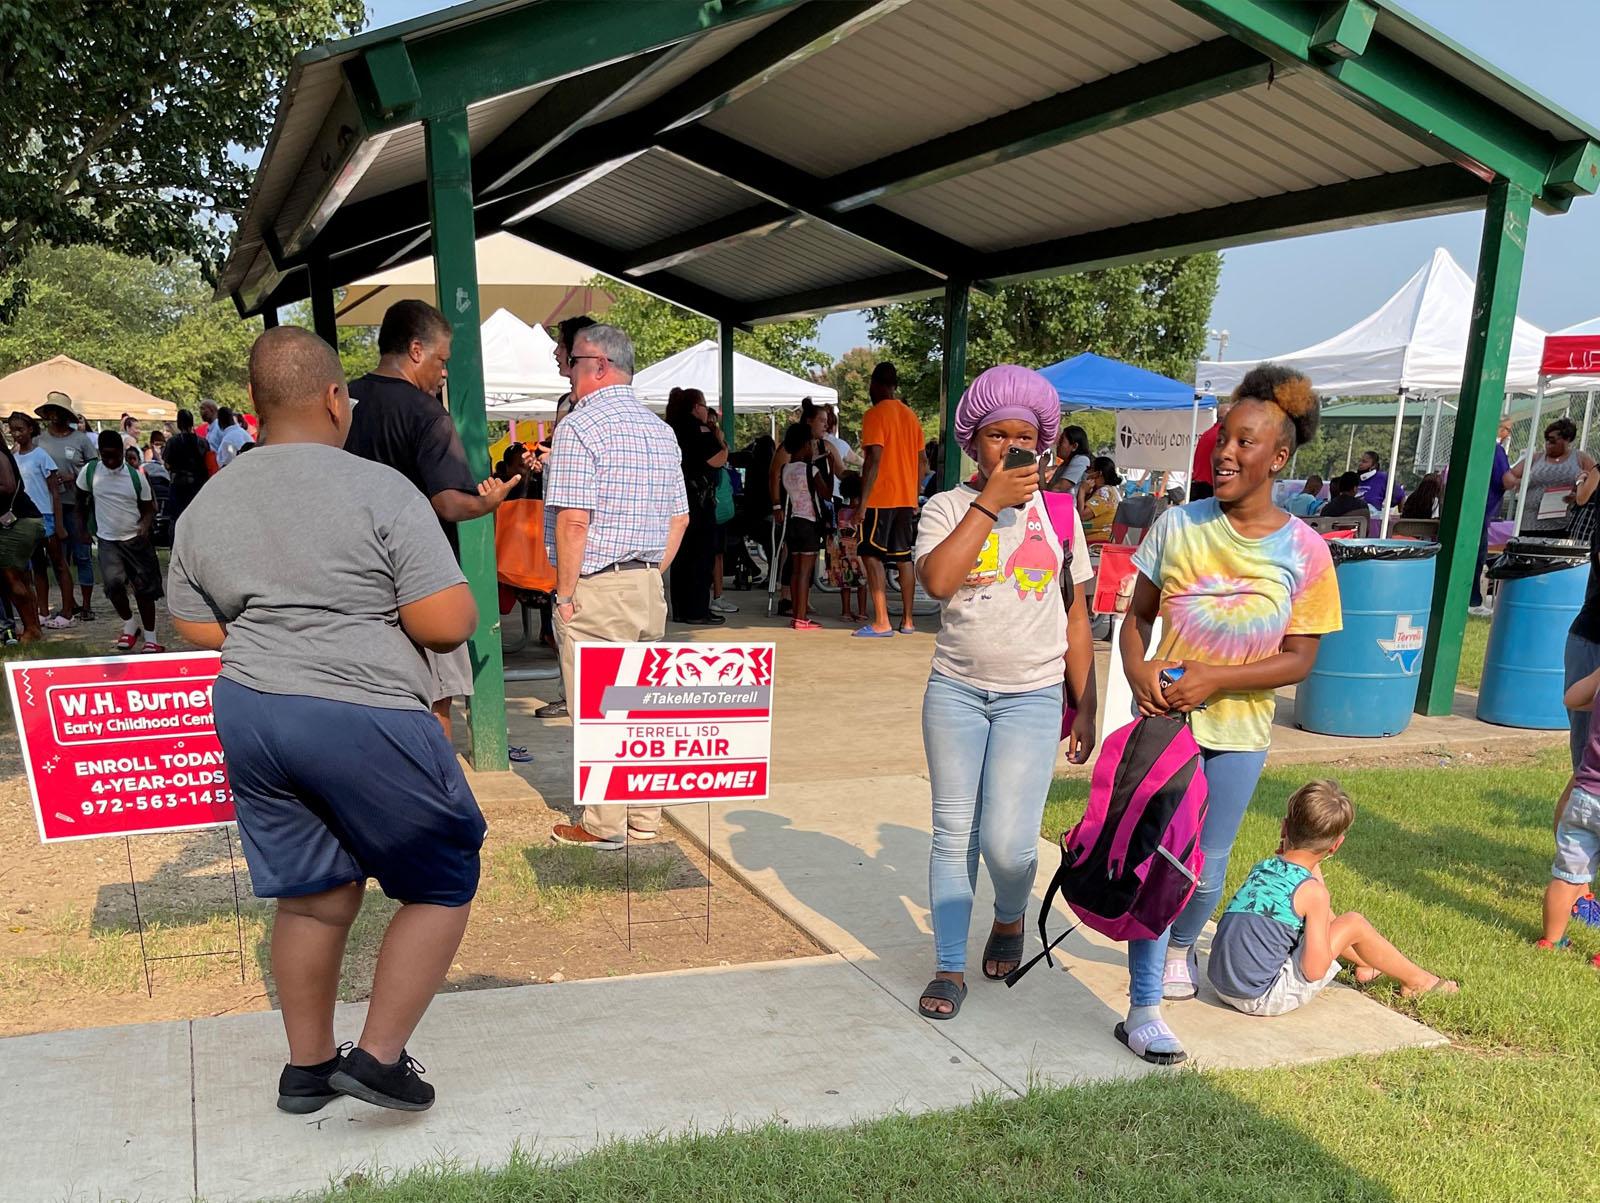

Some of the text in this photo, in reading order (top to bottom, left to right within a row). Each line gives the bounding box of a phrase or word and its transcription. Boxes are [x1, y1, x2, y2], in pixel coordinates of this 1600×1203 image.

[59, 692, 122, 716] W.H.
[642, 691, 758, 705] #TakeMeToTerrell
[64, 713, 214, 736] Early Childhood Cent
[627, 726, 720, 738] TERRELL ISD
[615, 738, 730, 758] JOB FAIR
[74, 750, 225, 776] ENROLL TODAY
[91, 770, 226, 795] 4-YEAR-OLDS
[627, 770, 757, 792] WELCOME!
